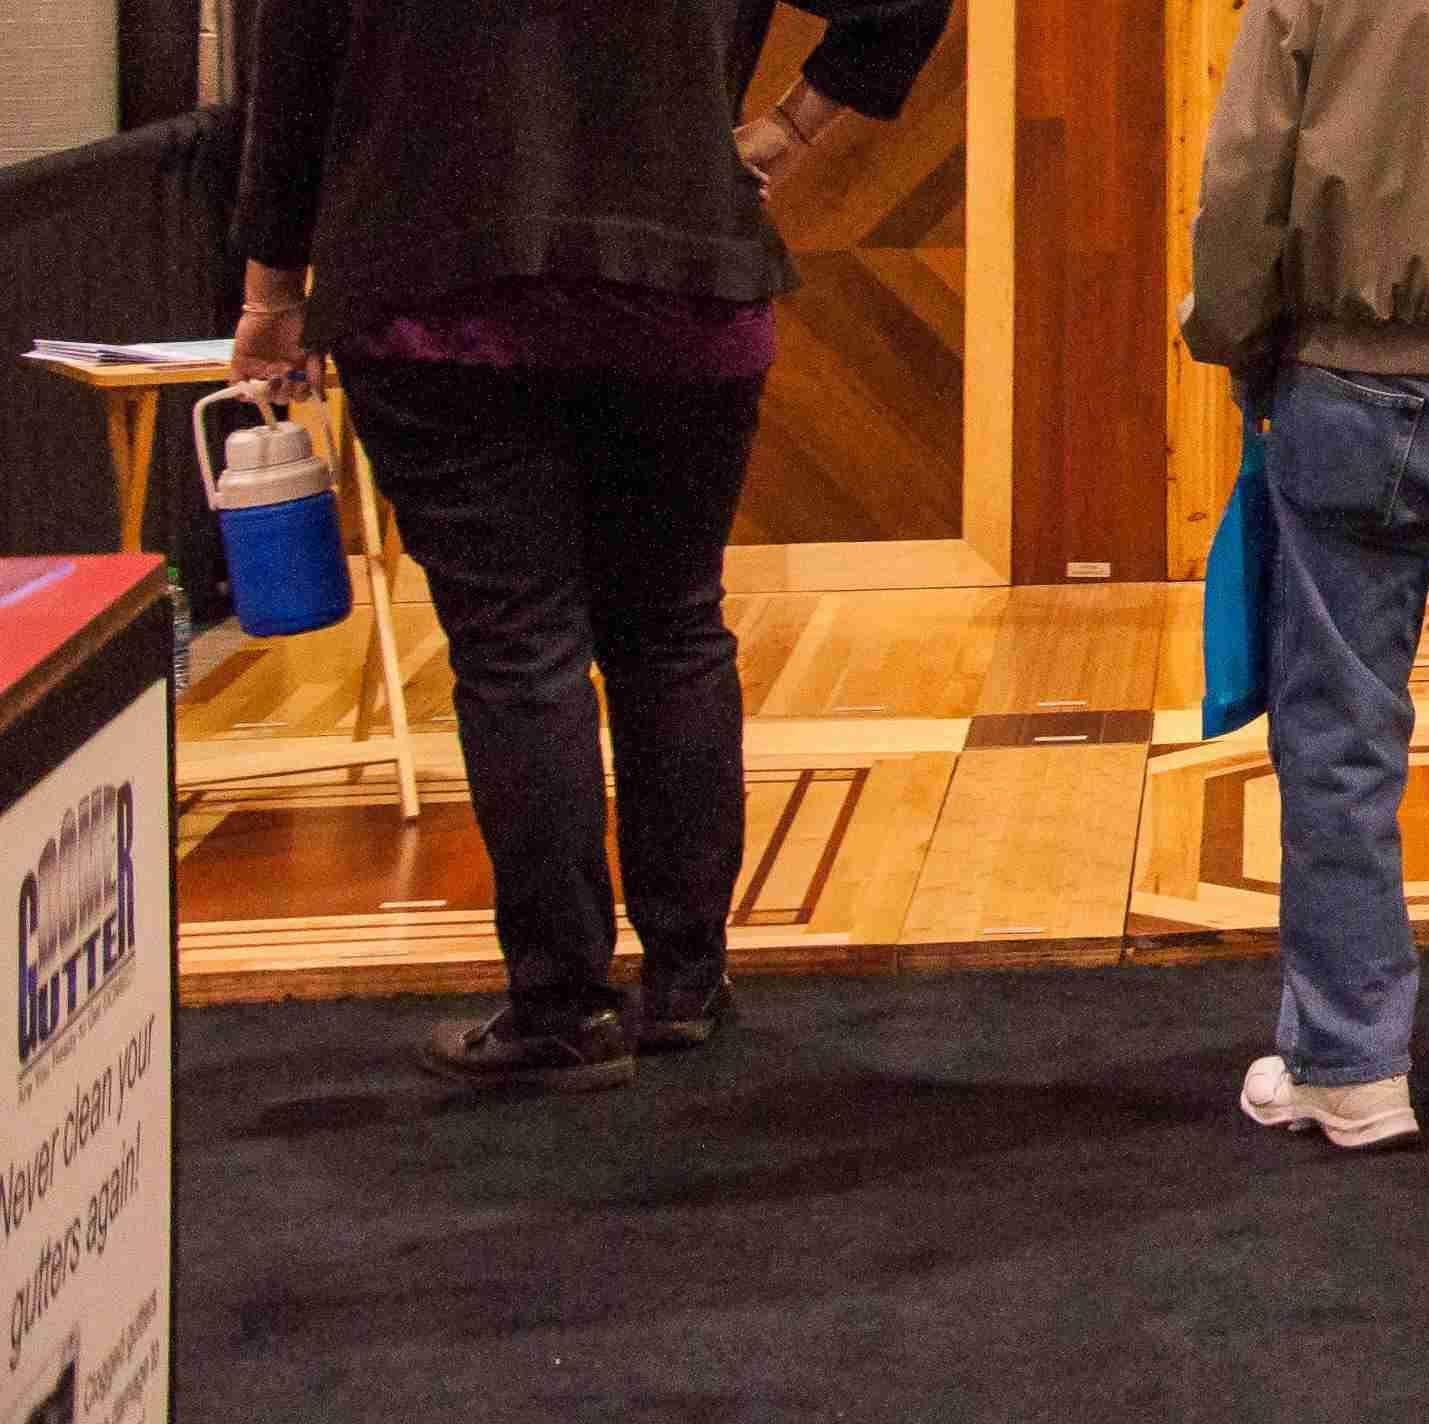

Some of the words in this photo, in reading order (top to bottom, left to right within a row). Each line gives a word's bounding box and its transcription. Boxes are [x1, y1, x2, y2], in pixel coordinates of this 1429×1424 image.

[63, 1066, 112, 1168] clean
[117, 1011, 156, 1125] your
[9, 1216, 81, 1372] gutters
[86, 1119, 142, 1259] again!
